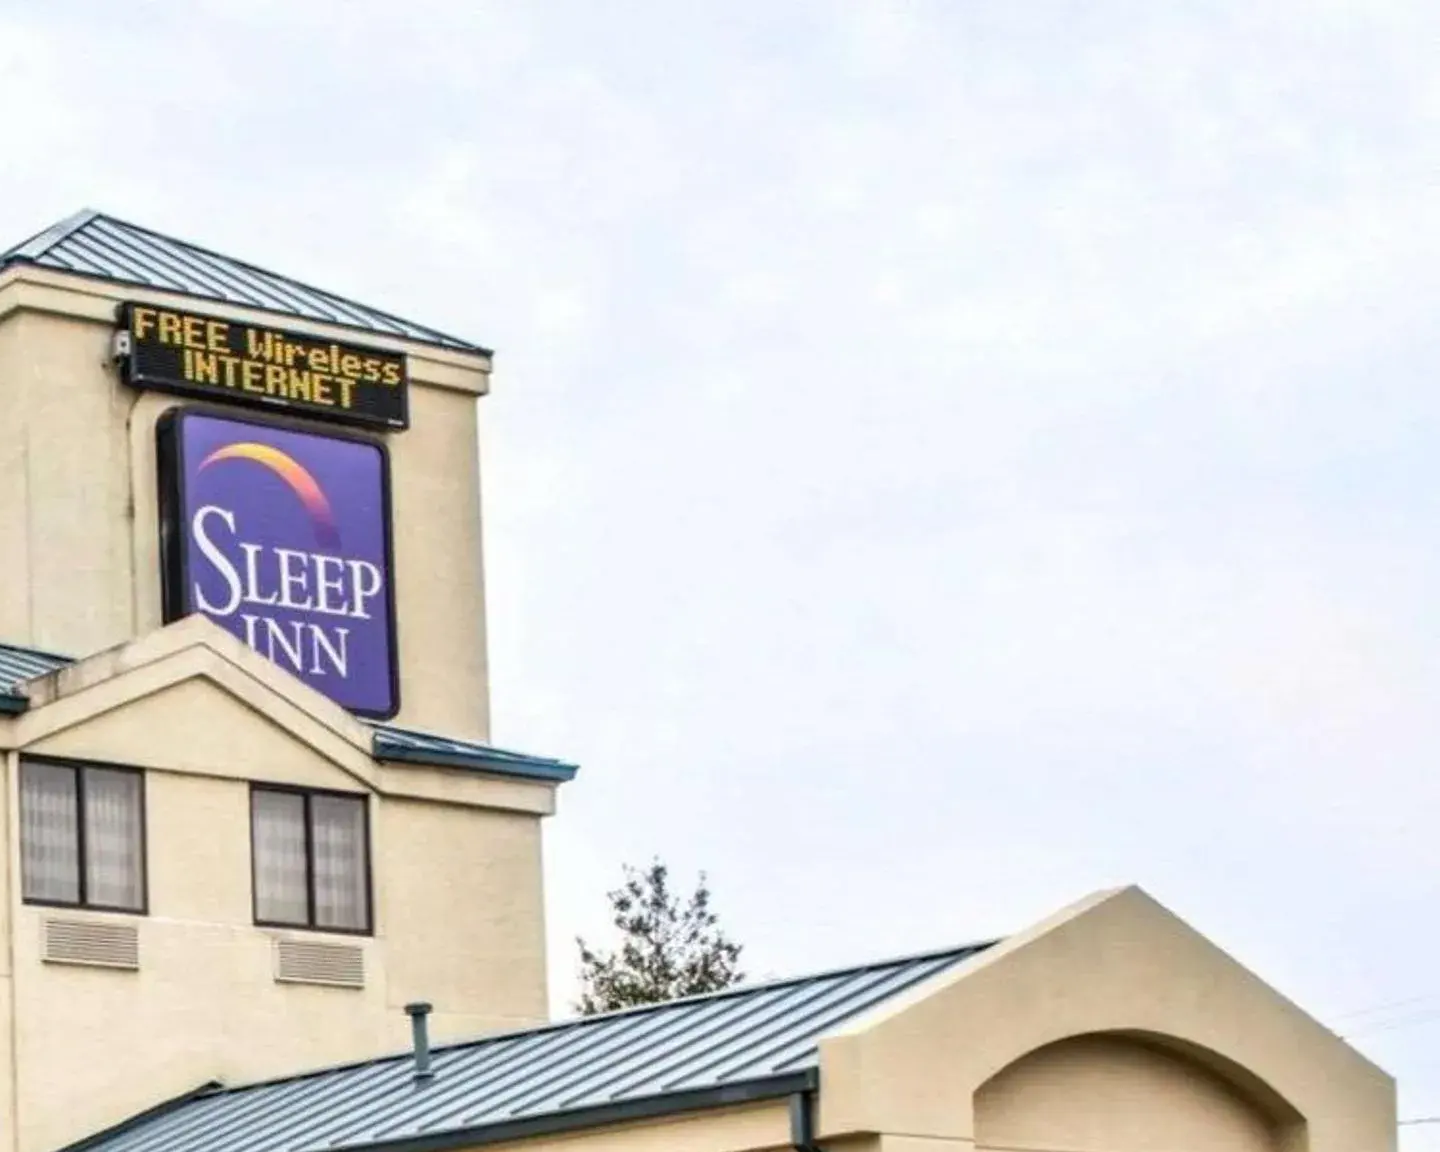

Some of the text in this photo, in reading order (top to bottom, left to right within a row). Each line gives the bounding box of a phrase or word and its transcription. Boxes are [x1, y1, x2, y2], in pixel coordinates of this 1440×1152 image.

[133, 306, 401, 385] FREE Wireless
[183, 349, 356, 409] INTERNET
[192, 504, 382, 619] SLEEP
[240, 614, 349, 679] INN
